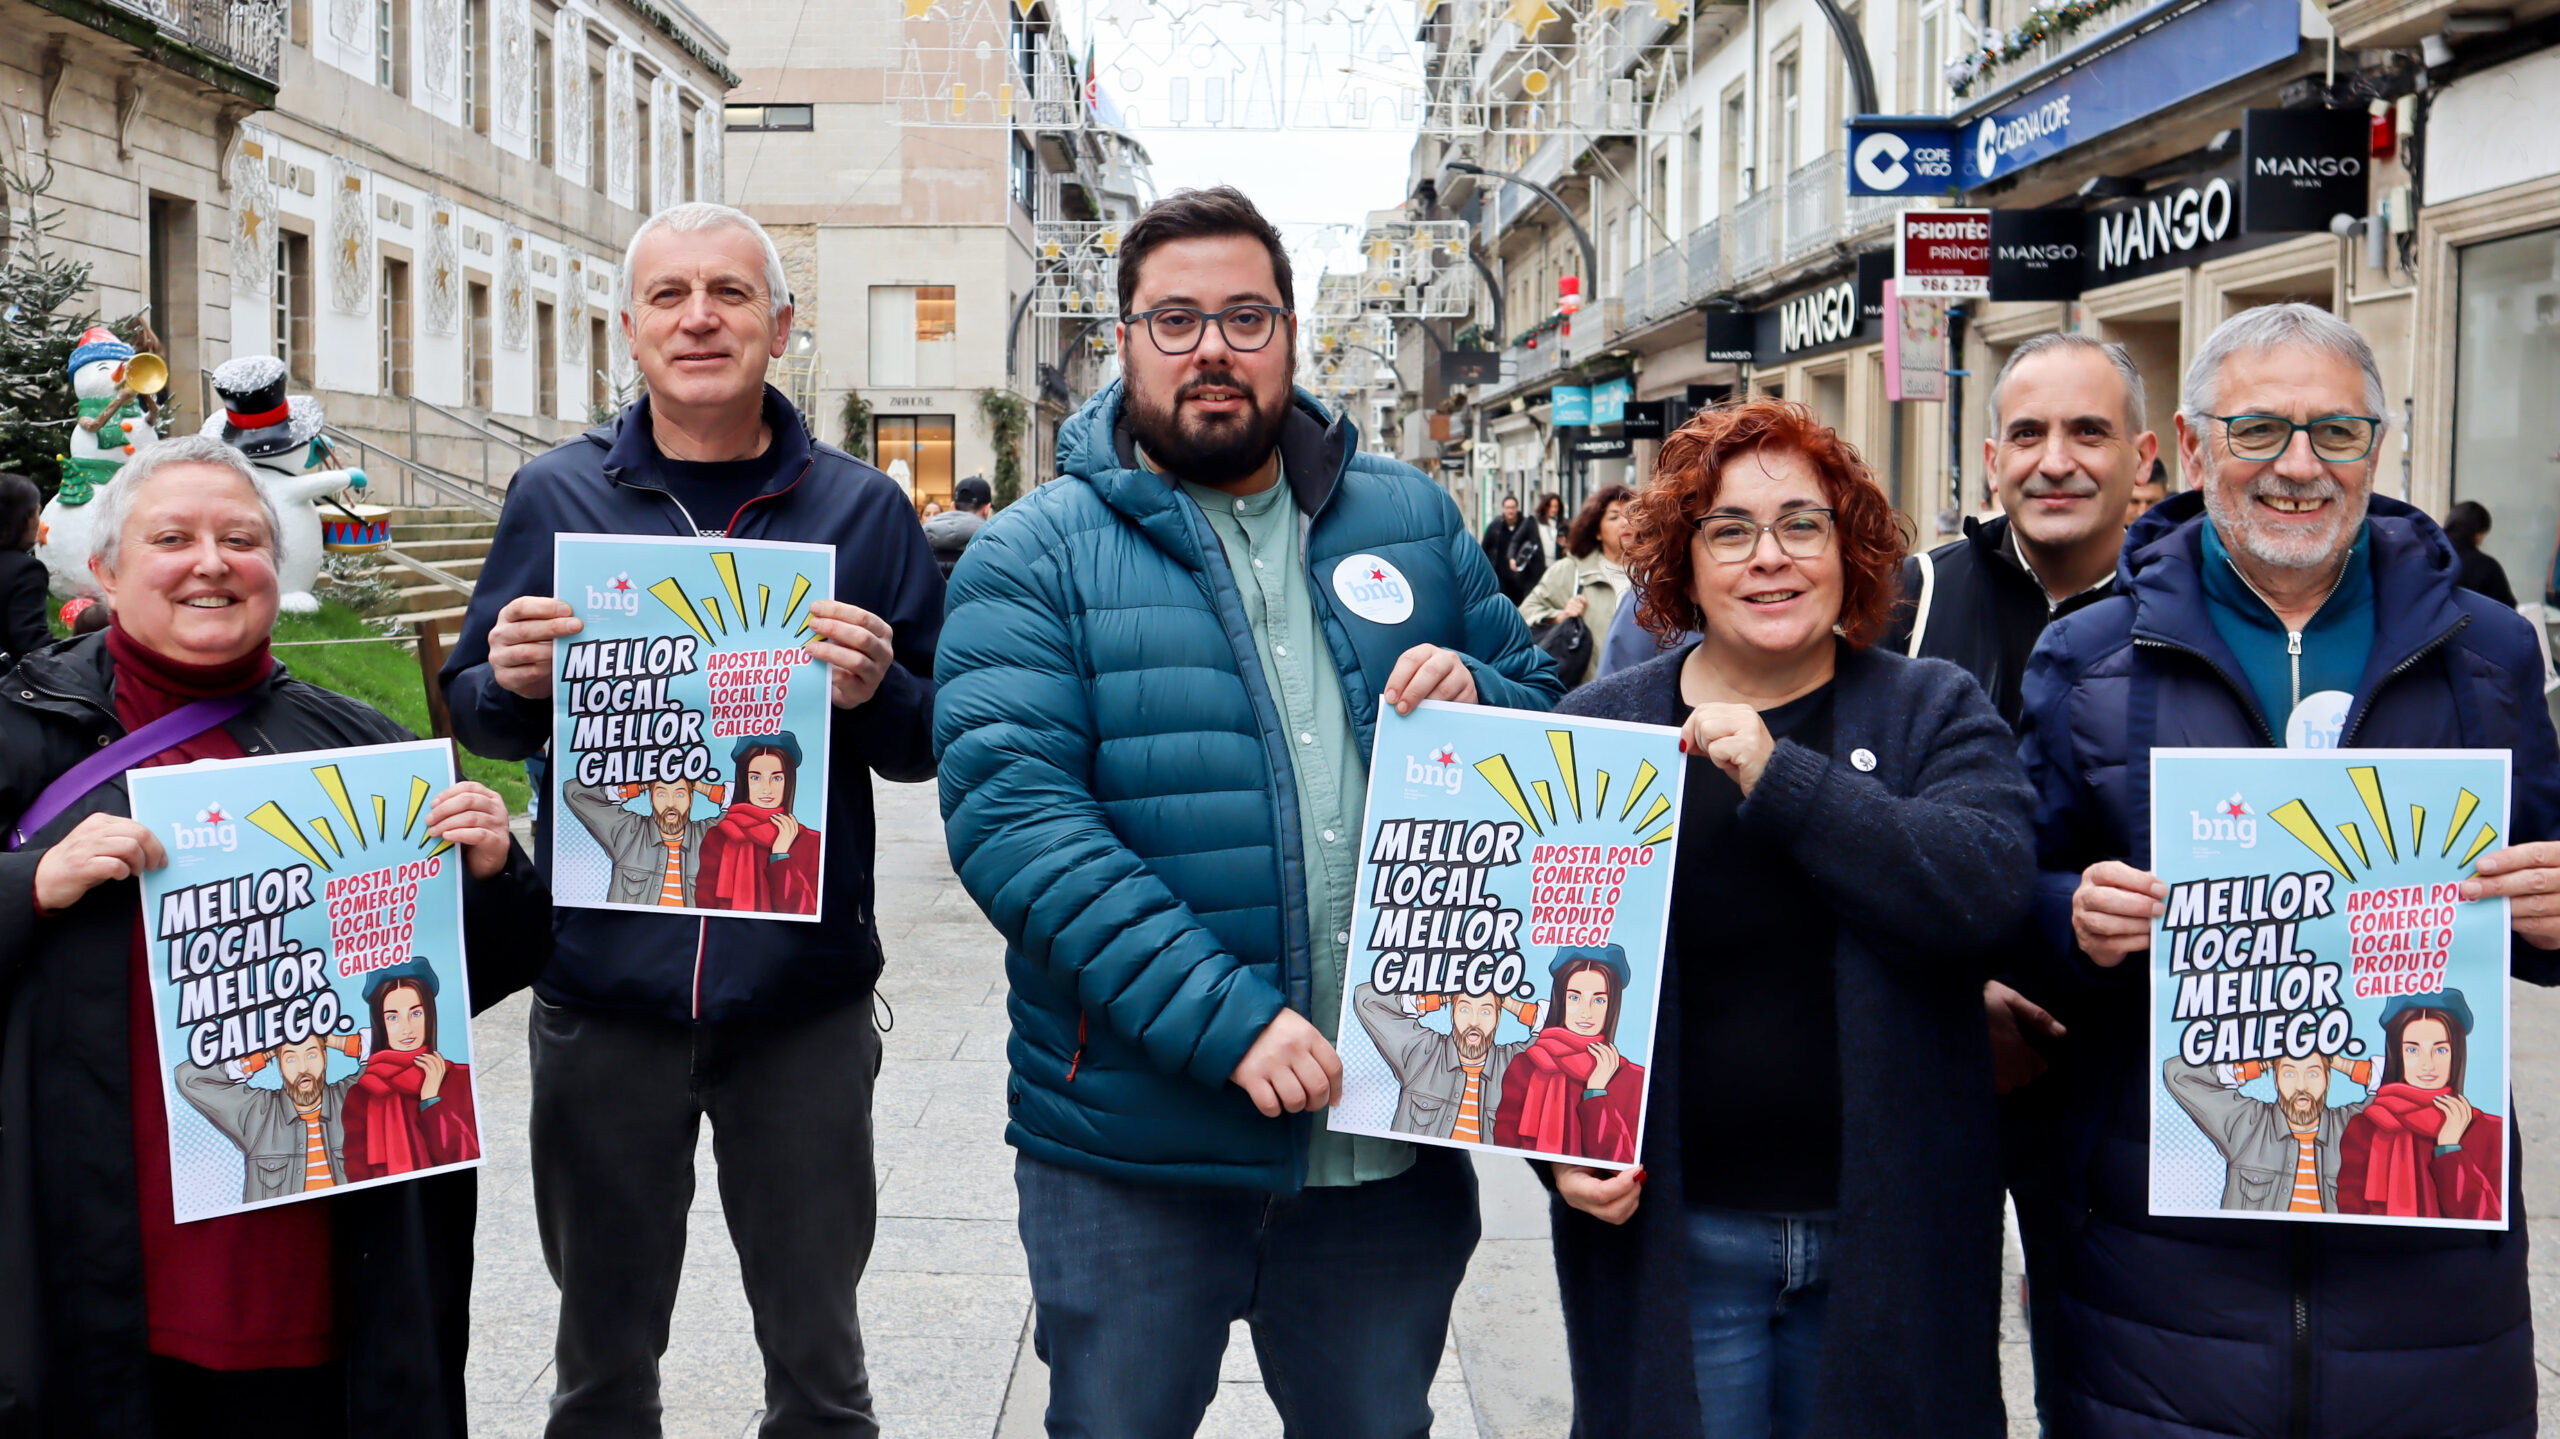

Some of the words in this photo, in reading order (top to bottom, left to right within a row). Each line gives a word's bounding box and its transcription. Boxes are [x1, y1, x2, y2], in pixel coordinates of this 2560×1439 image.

[1997, 112, 2041, 155] CADENA
[2041, 95, 2071, 135] COPE
[1914, 148, 1951, 162] COPE
[1914, 163, 1952, 176] VIGO
[2255, 156, 2361, 176] MANGO
[2293, 178, 2322, 188] MAN
[1906, 217, 1991, 240] PSICOTÉC
[2098, 177, 2231, 271] MANGO
[1997, 244, 2077, 260] MANGO
[1921, 278, 1948, 291] 986
[1954, 278, 1981, 291] 227
[1780, 281, 1855, 354] MANGO
[1709, 350, 1752, 361] MANGO
[586, 585, 639, 615] bng
[1344, 580, 1405, 603] bng
[563, 636, 697, 680] MELLOR
[707, 651, 767, 670] APOSTA
[773, 648, 813, 666] POLO
[709, 667, 790, 688] COMERCIO
[570, 678, 682, 716] LOCAL.
[710, 688, 756, 705] LOCAL
[762, 686, 770, 701] E
[776, 685, 787, 700] O
[712, 702, 783, 720] PRODUTO
[571, 711, 703, 751] MELLOR
[713, 718, 781, 737] GALEGO!
[578, 746, 720, 787] GALEGO.
[1404, 755, 1463, 795] bng
[171, 821, 239, 852] bng
[1370, 819, 1522, 865] MELLOR
[2190, 811, 2258, 848] bng
[1532, 845, 1600, 864] APOSTA
[1607, 846, 1653, 866] POLO
[325, 868, 392, 901] APOSTA
[398, 858, 440, 883] POLO
[1372, 863, 1500, 908] LOCAL.
[1532, 866, 1626, 885] COMERCIO
[158, 865, 314, 939] MELLOR
[329, 882, 418, 919] COMERCIO
[1532, 887, 1584, 905] LOCAL
[1591, 887, 1600, 905] E
[1607, 887, 1620, 905] O
[2164, 871, 2334, 930] MELLOR
[2347, 887, 2423, 912] APOSTA
[331, 908, 383, 939] LOCAL
[389, 905, 398, 925] E
[402, 903, 416, 922] O
[1369, 907, 1522, 949] MELLOR
[1532, 907, 1614, 925] PRODUTO
[2350, 906, 2455, 935] COMERCIO
[170, 916, 301, 983] LOCAL.
[335, 922, 413, 957] PRODUTO
[1532, 926, 1611, 946] GALEGO!
[2170, 923, 2316, 976] LOCAL.
[2352, 933, 2411, 955] LOCAL
[2420, 931, 2430, 950] E
[2437, 929, 2452, 948] O
[339, 943, 412, 977] GALEGO!
[1372, 950, 1534, 997] GALEGO.
[2353, 950, 2447, 975] PRODUTO
[178, 950, 329, 1027] MELLOR
[2172, 963, 2342, 1020] MELLOR
[2355, 971, 2444, 998] GALEGO!
[189, 992, 353, 1068] GALEGO.
[2180, 1008, 2365, 1067] GALEGO.
